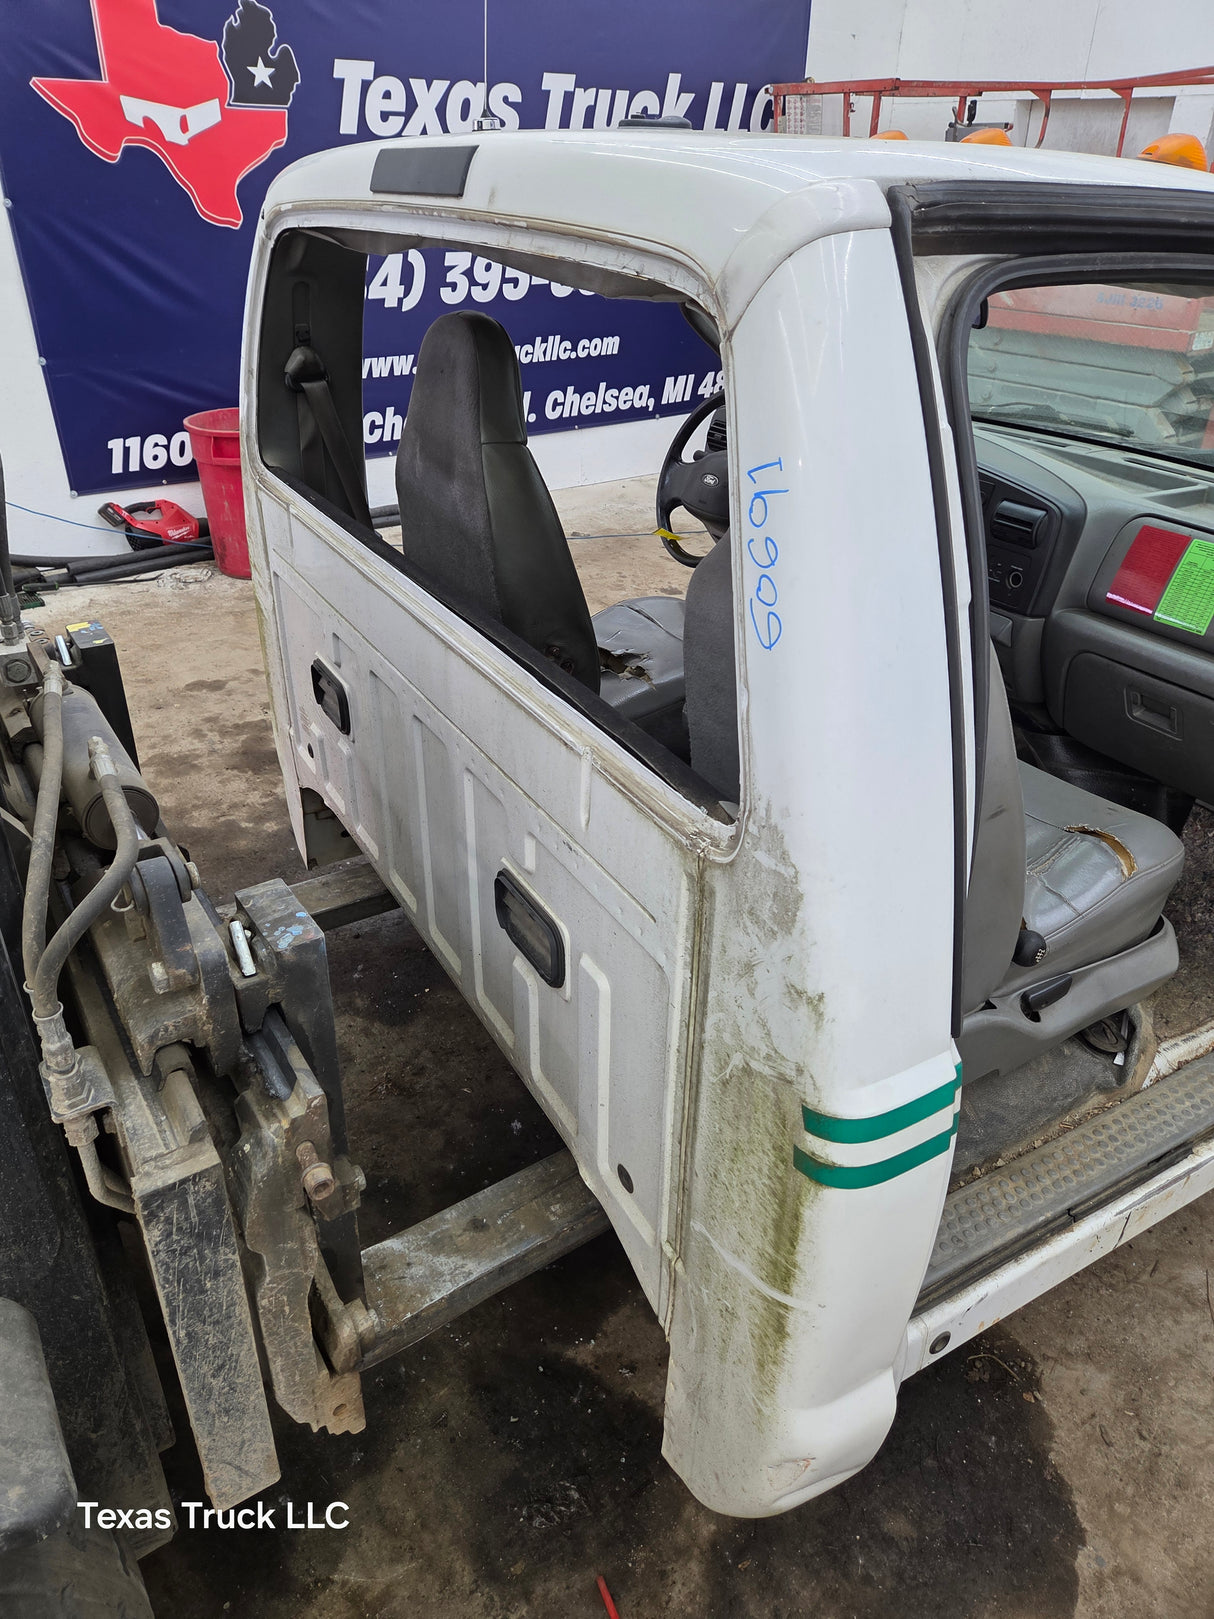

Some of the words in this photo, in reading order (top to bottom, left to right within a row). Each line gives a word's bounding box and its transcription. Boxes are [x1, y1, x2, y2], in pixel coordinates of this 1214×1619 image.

[333, 58, 523, 137] Texas
[541, 72, 696, 131] Truck
[364, 248, 426, 312] 4)
[545, 382, 655, 421] Chelsea,
[661, 373, 695, 404] MI
